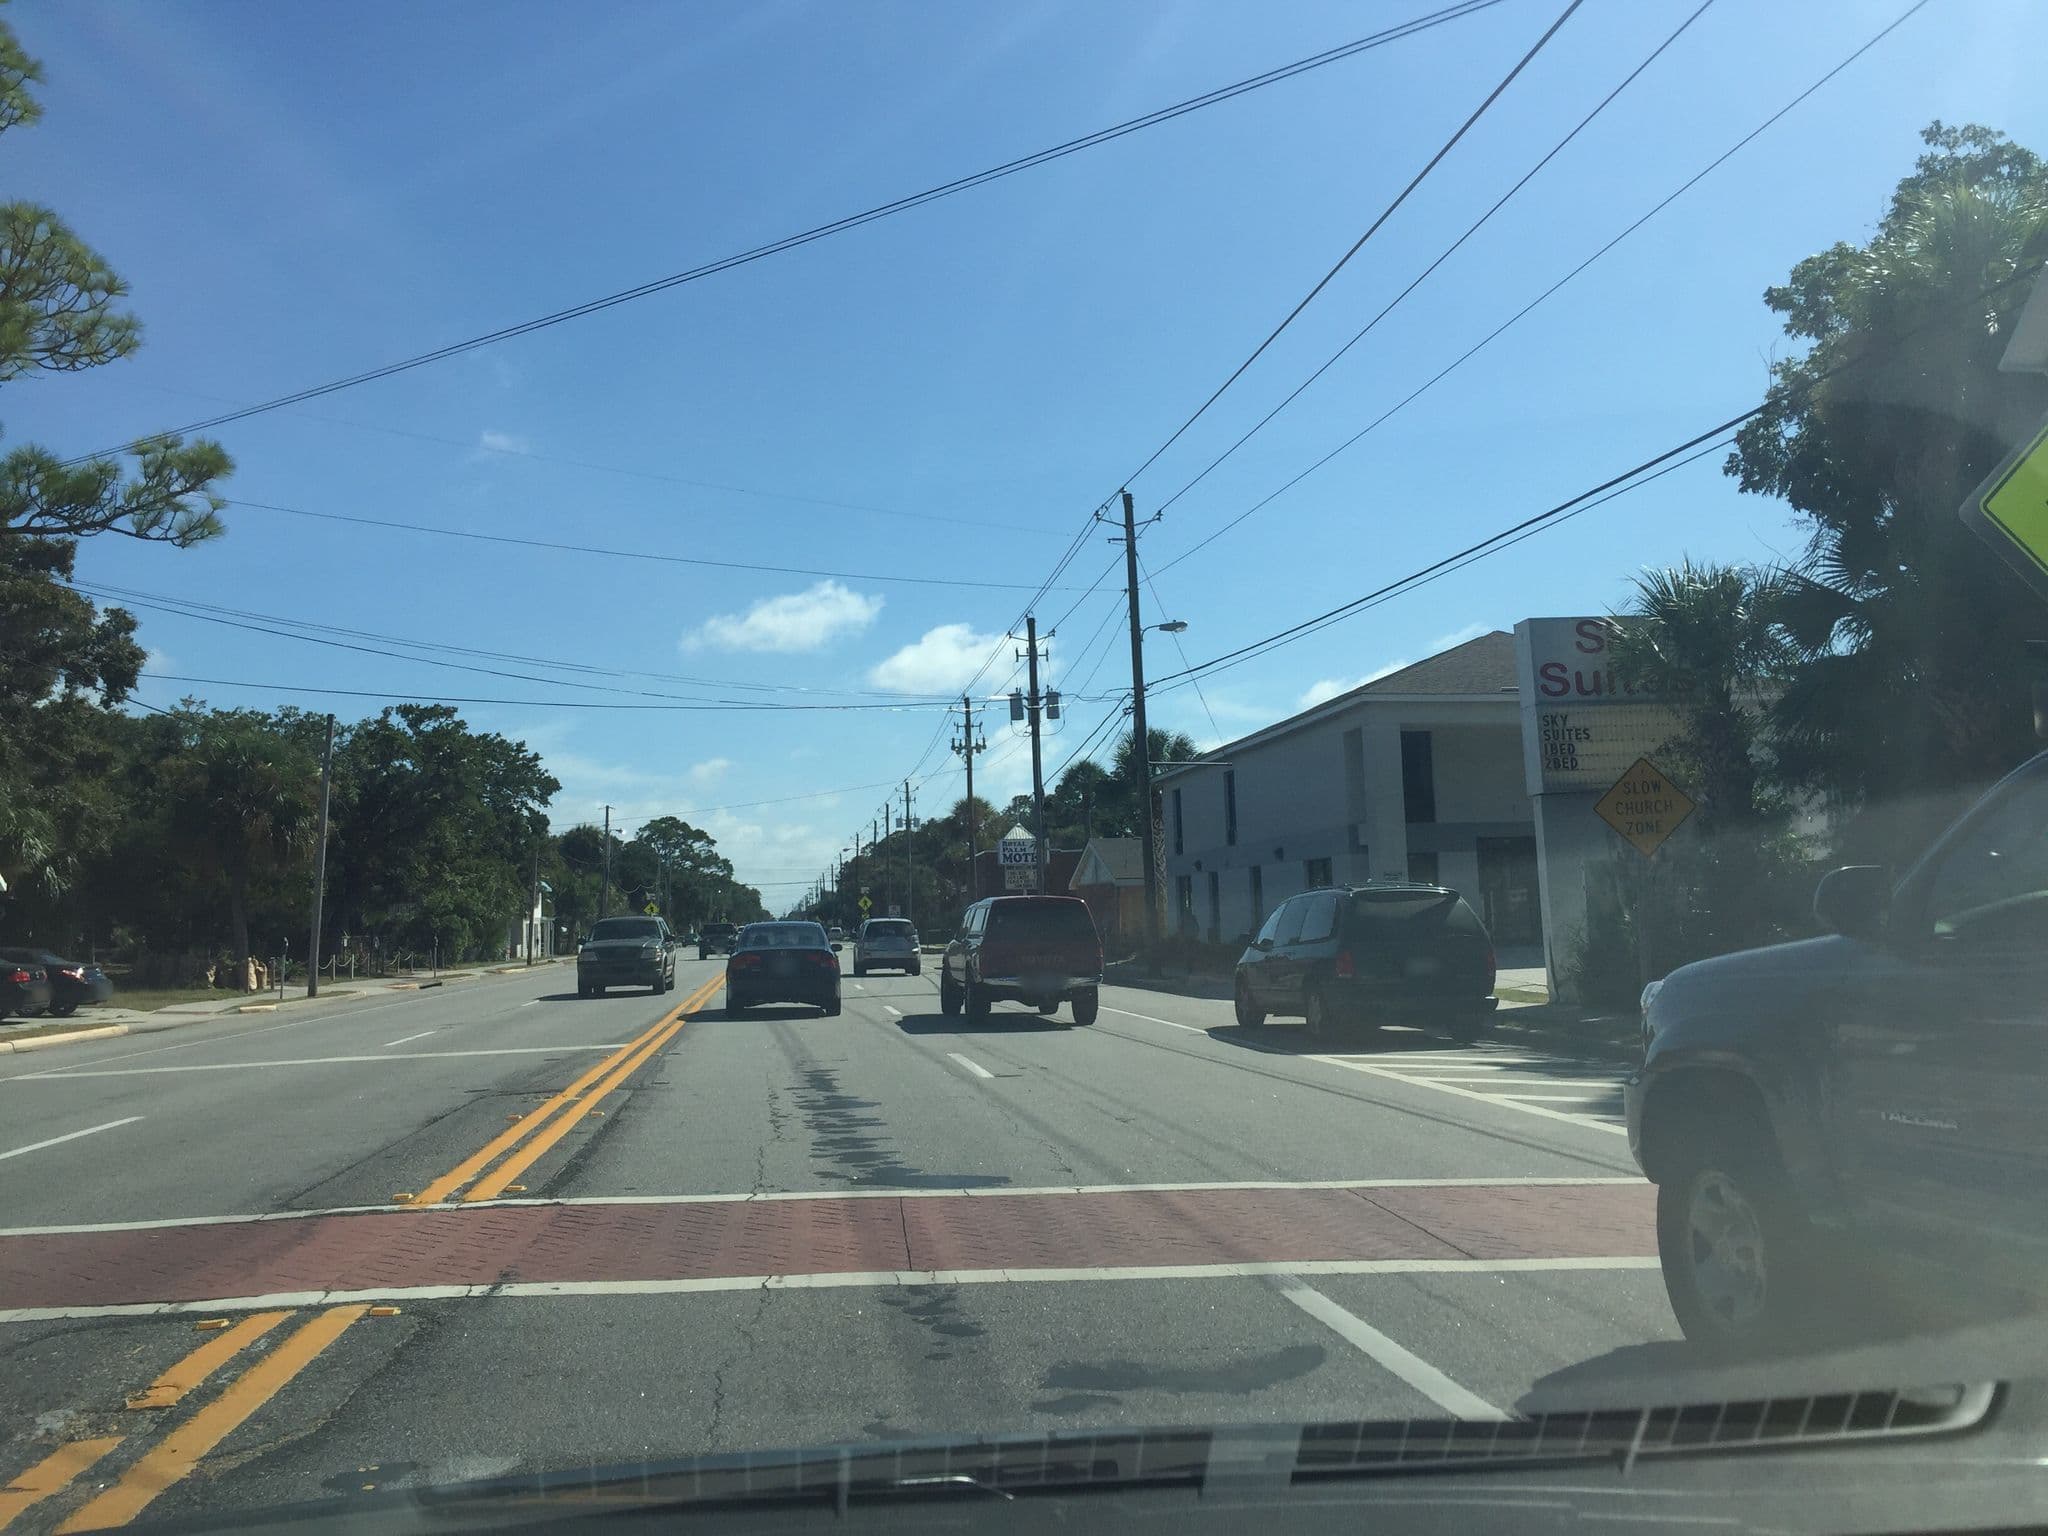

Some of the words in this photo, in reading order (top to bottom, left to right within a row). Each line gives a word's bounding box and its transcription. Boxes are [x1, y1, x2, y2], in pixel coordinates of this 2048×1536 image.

[1542, 715, 1568, 728] SKY
[1543, 728, 1591, 742] SUITES
[1544, 756, 1579, 770] 2BED
[1622, 780, 1662, 795] SLOW
[1615, 799, 1674, 816] CHURCH
[1625, 821, 1665, 836] ZONE
